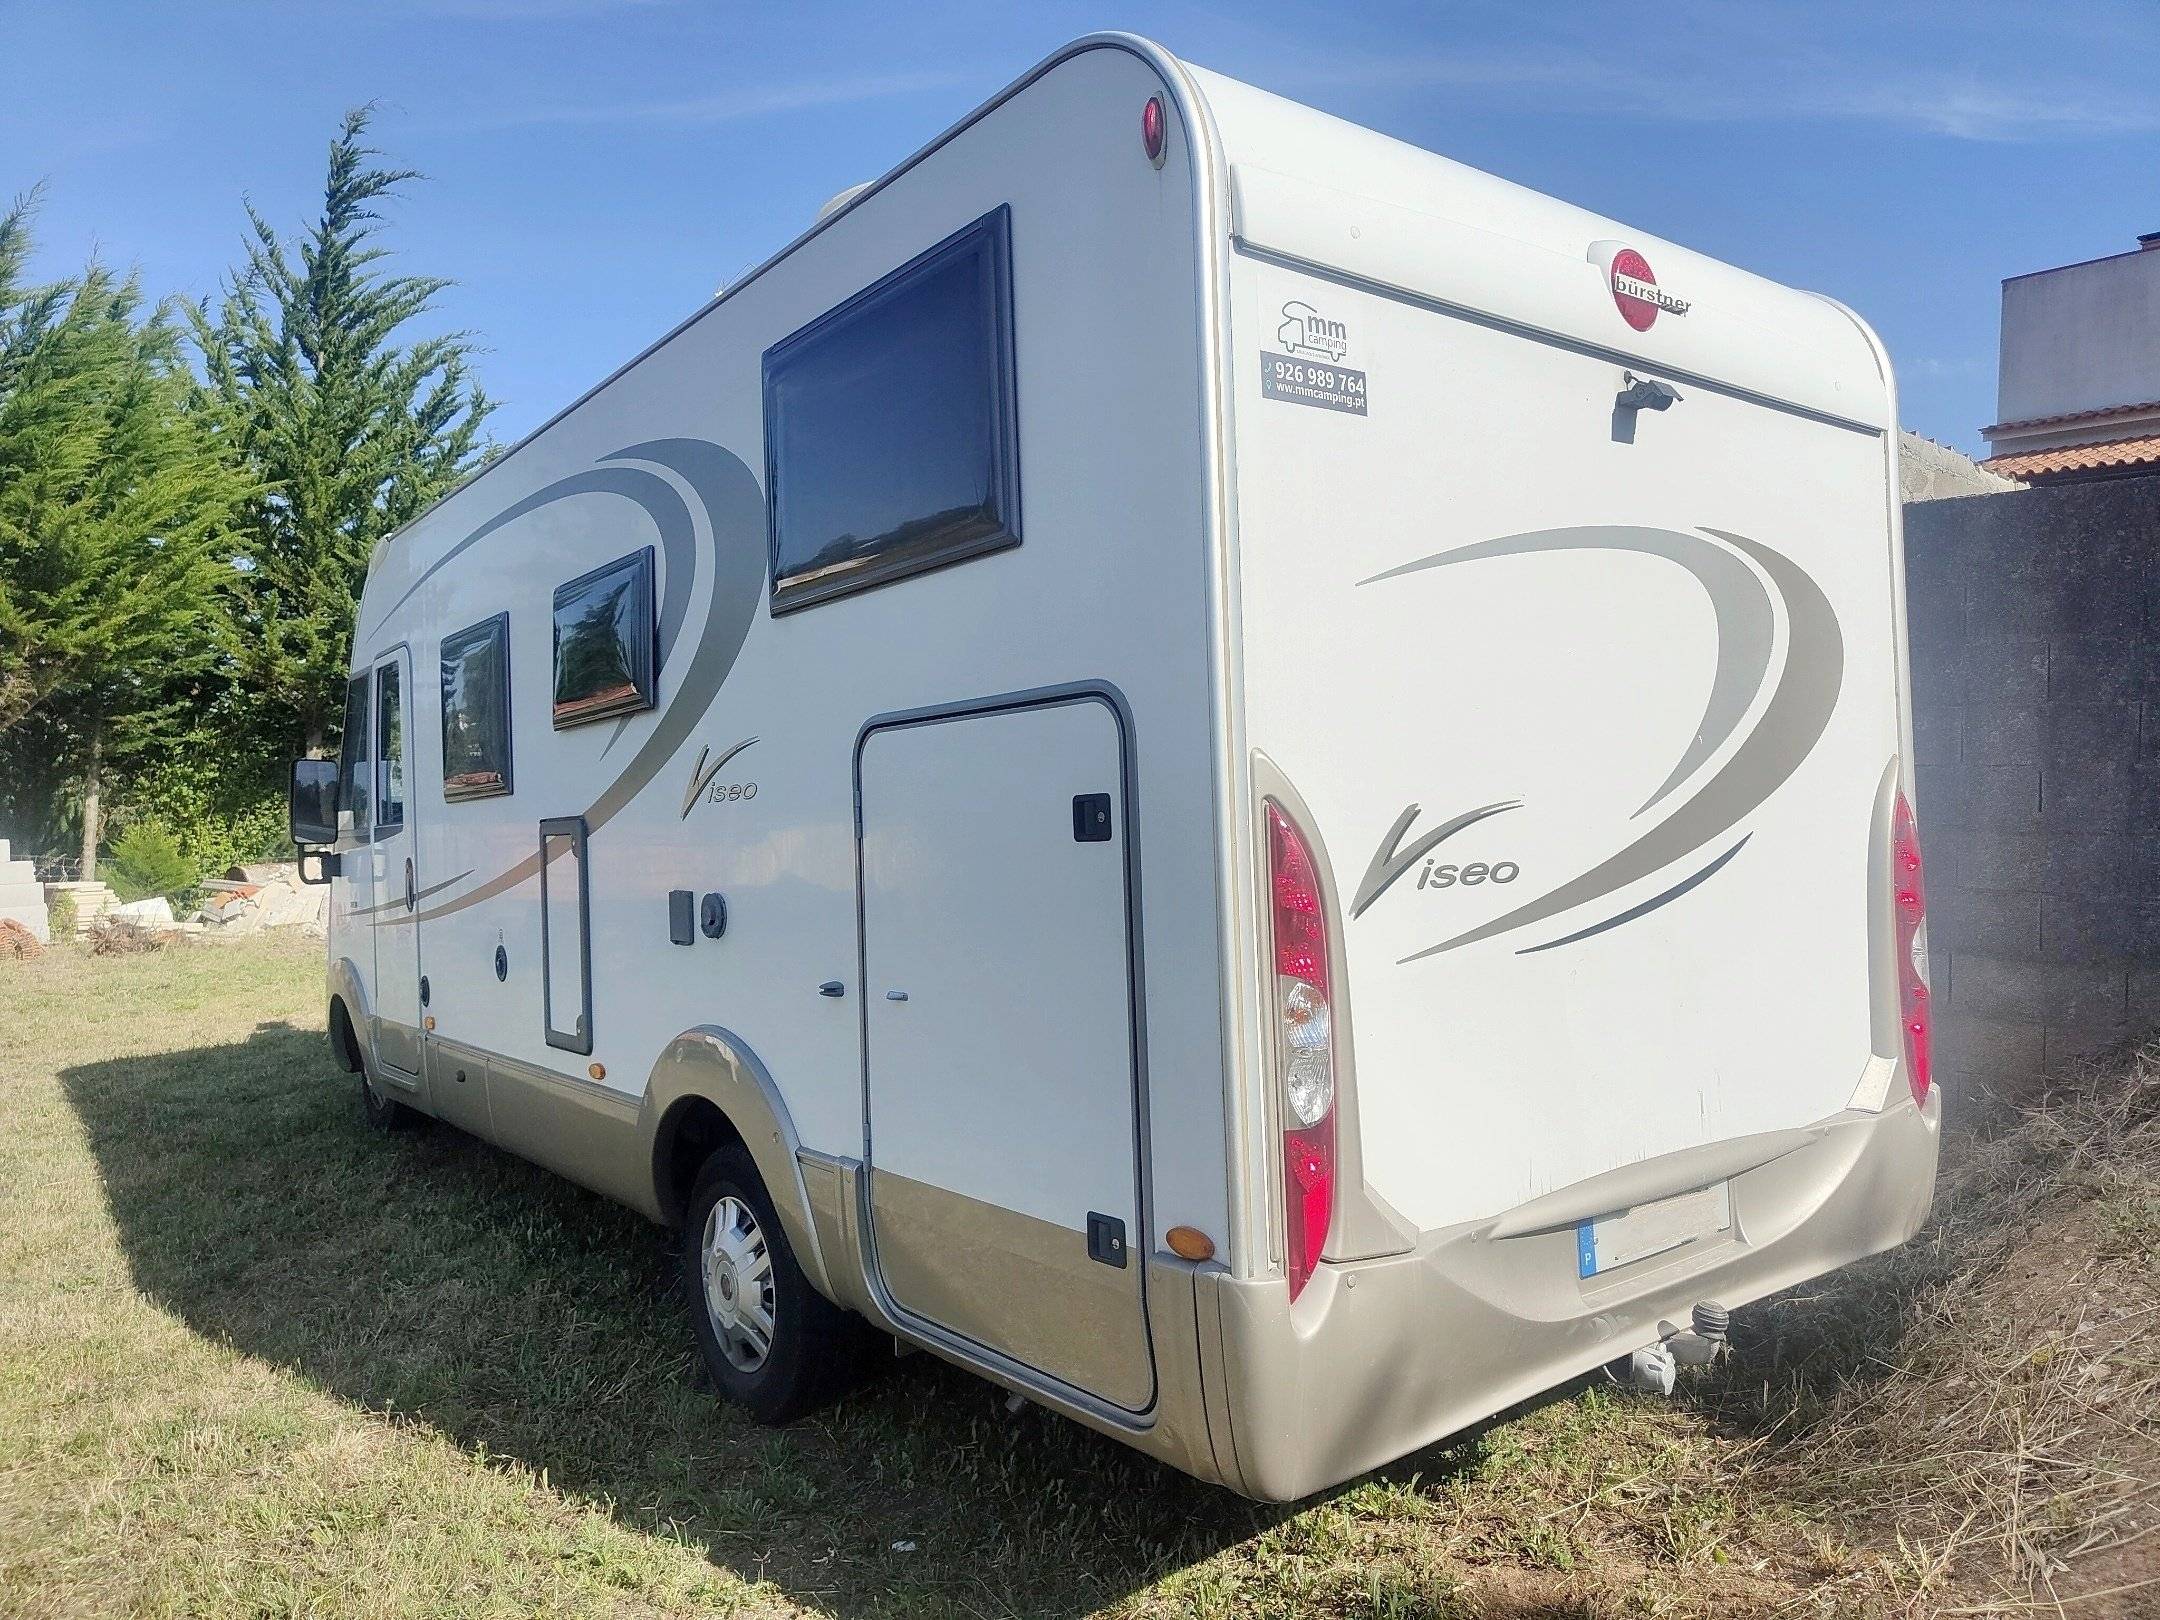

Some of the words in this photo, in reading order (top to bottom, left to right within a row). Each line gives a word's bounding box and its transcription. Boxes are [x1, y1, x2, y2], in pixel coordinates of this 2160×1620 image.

[1616, 275, 1692, 313] bürstner
[1307, 315, 1347, 340] mm
[1308, 333, 1347, 354] camping
[1275, 361, 1304, 383] 926
[1307, 367, 1335, 389] 989
[1338, 373, 1365, 395] 764
[680, 735, 761, 821] Viseo
[1348, 799, 1525, 921] Viseo
[1584, 1252, 1592, 1266] P
